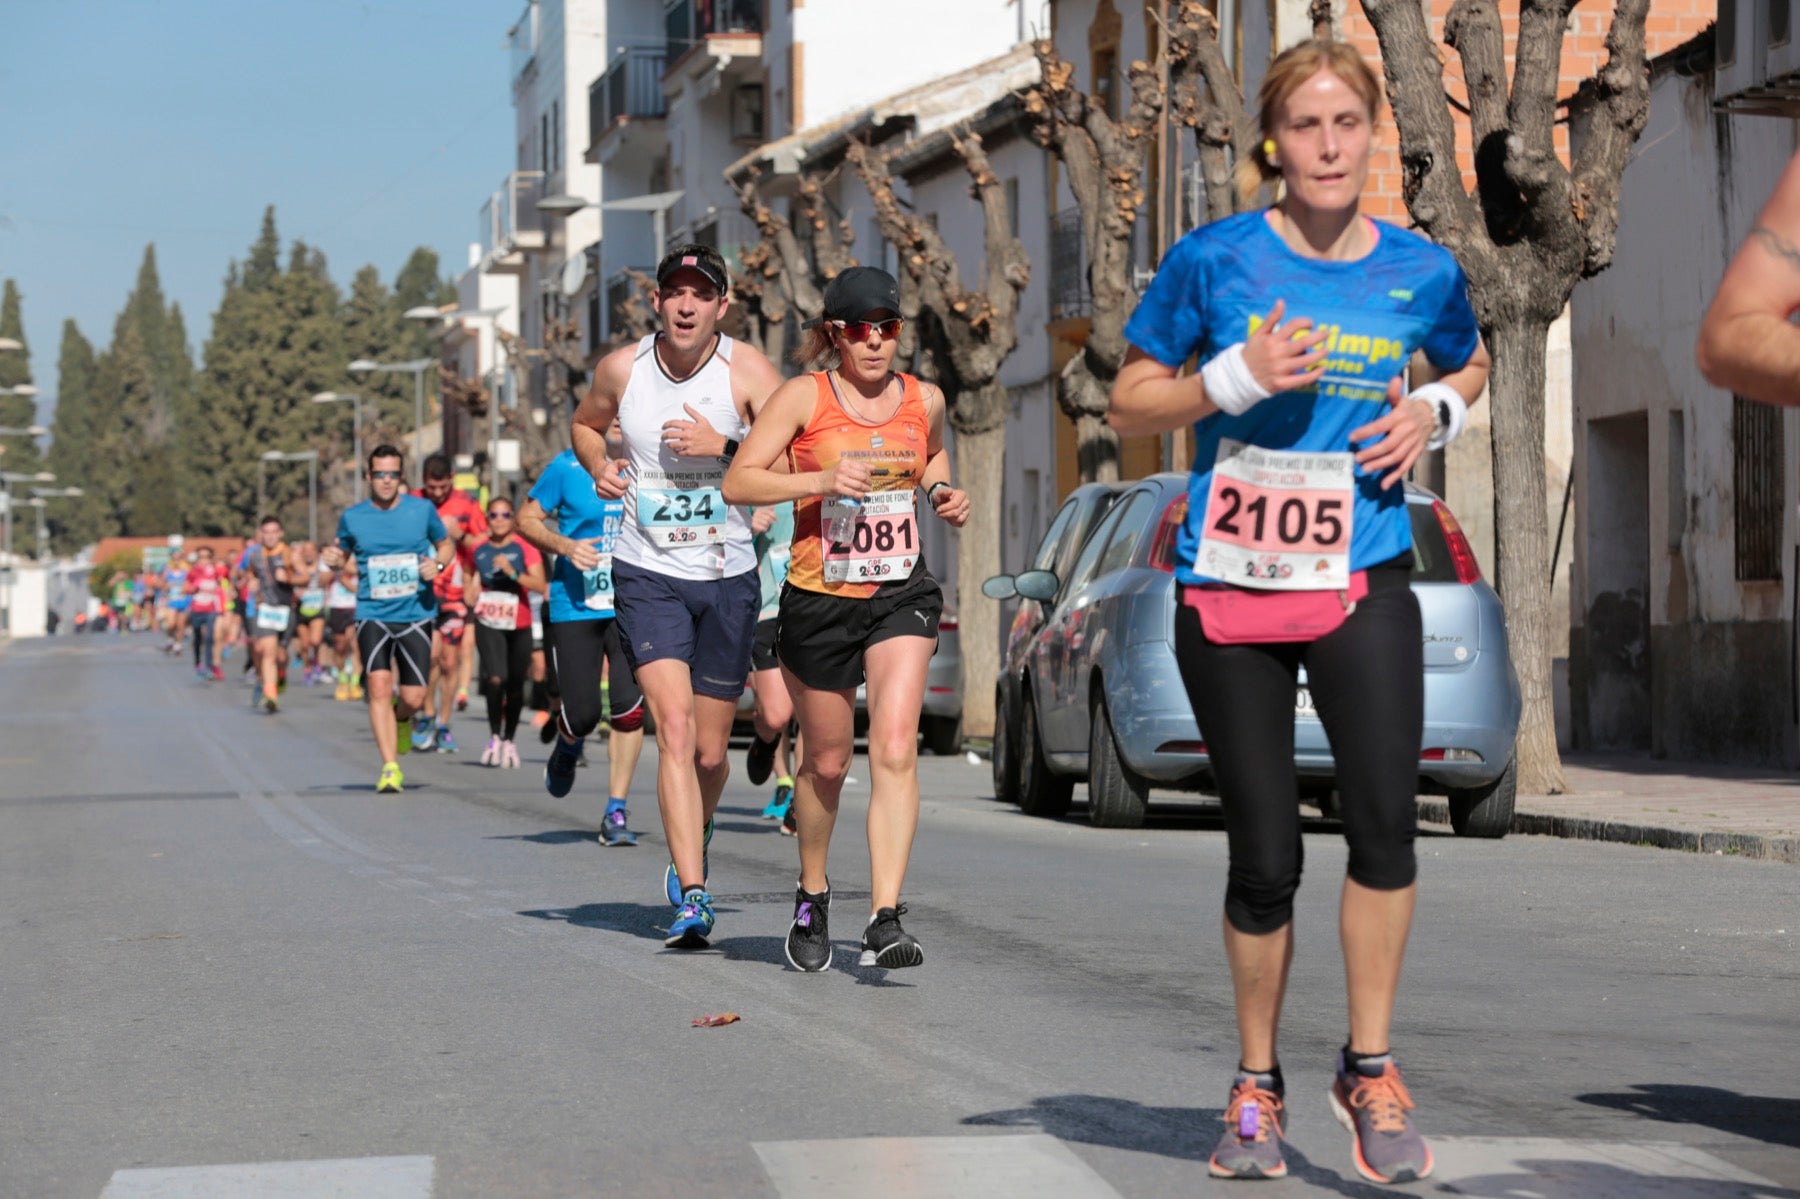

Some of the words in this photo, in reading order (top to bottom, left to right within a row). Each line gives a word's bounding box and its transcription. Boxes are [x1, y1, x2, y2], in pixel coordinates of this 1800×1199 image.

[675, 471, 695, 480] PREMIO
[653, 494, 713, 521] 234
[1214, 486, 1342, 545] 2105
[378, 568, 410, 584] 286
